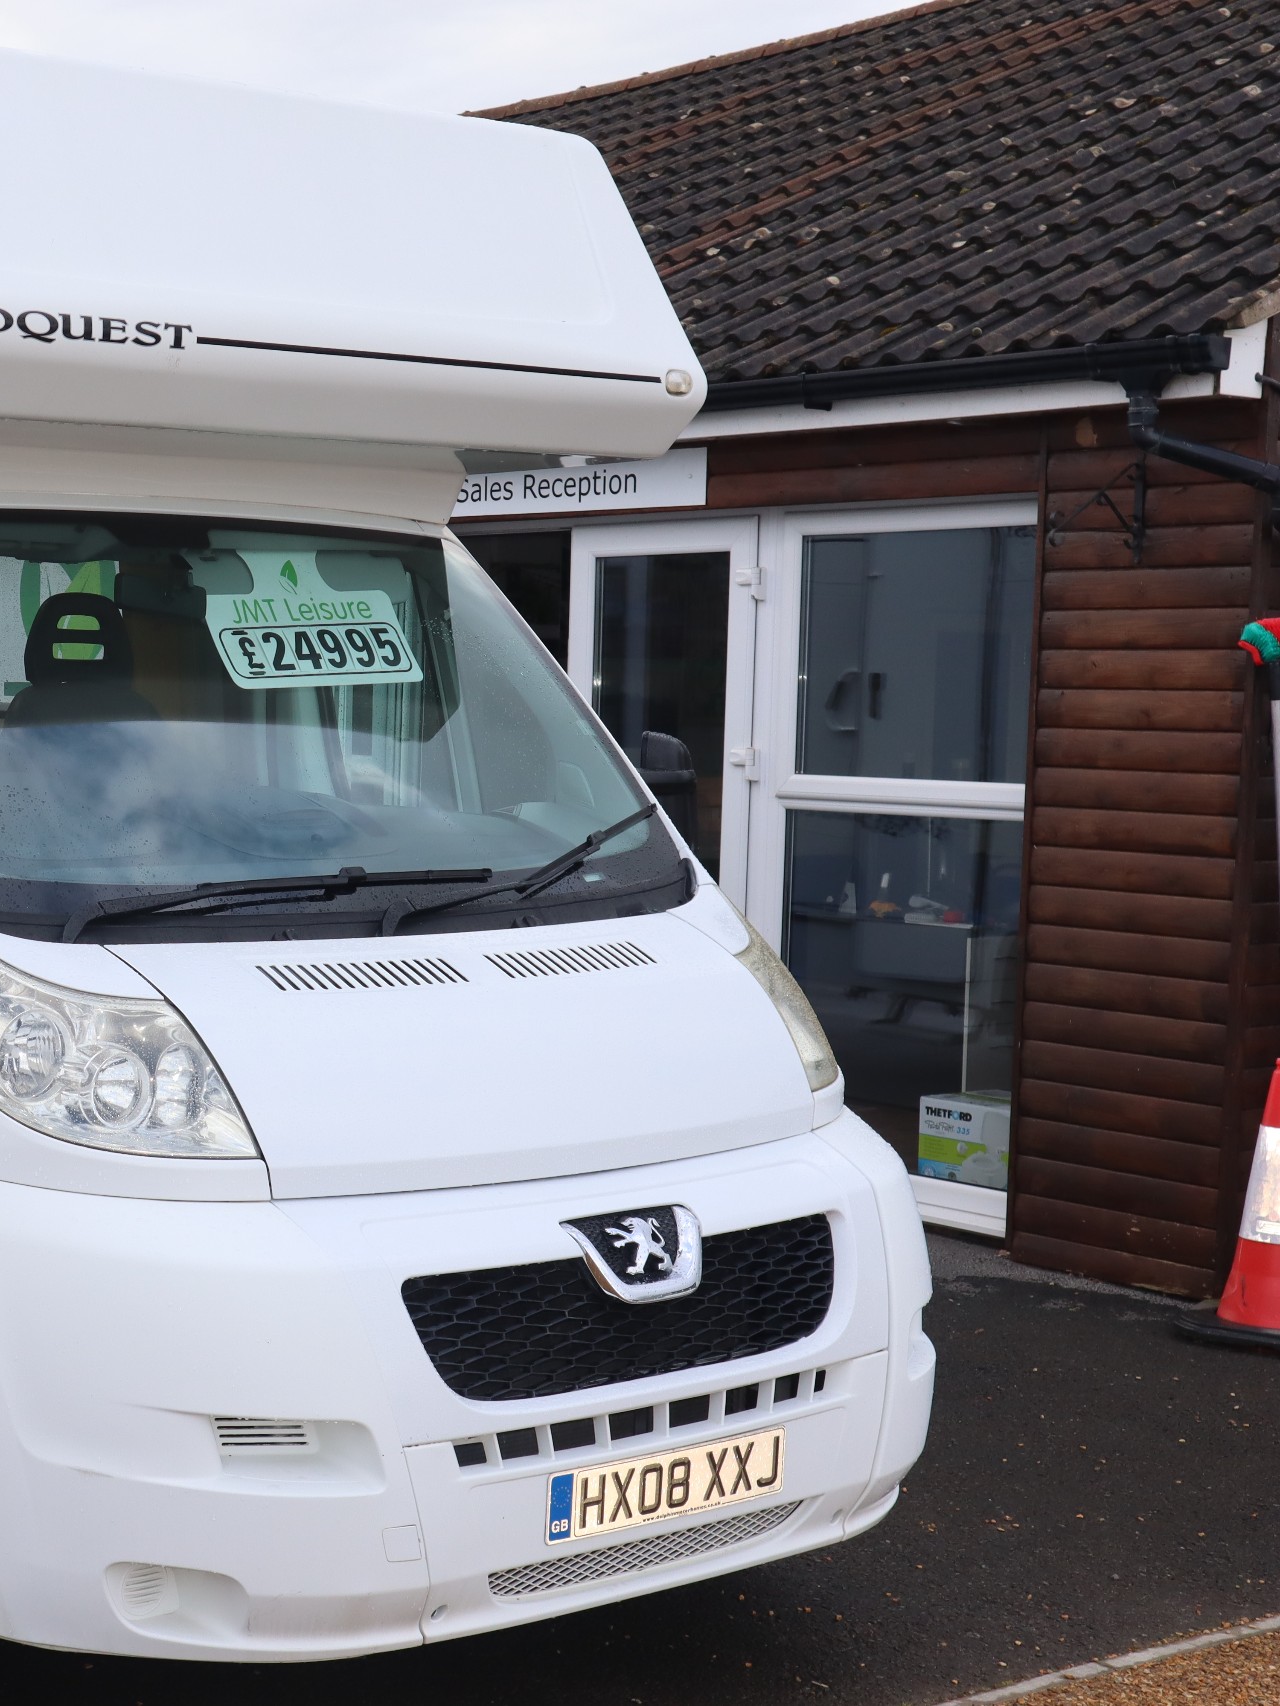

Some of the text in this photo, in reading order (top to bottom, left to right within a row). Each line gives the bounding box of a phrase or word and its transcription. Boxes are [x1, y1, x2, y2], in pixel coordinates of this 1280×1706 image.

[457, 469, 637, 503] Sales Reception
[232, 597, 373, 624] JMT Leisure
[237, 627, 402, 671] £24995
[925, 1106, 973, 1122] THETFORD
[956, 1126, 970, 1136] 335
[578, 1435, 780, 1529] HX08 XXJ
[551, 1518, 569, 1533] GB
